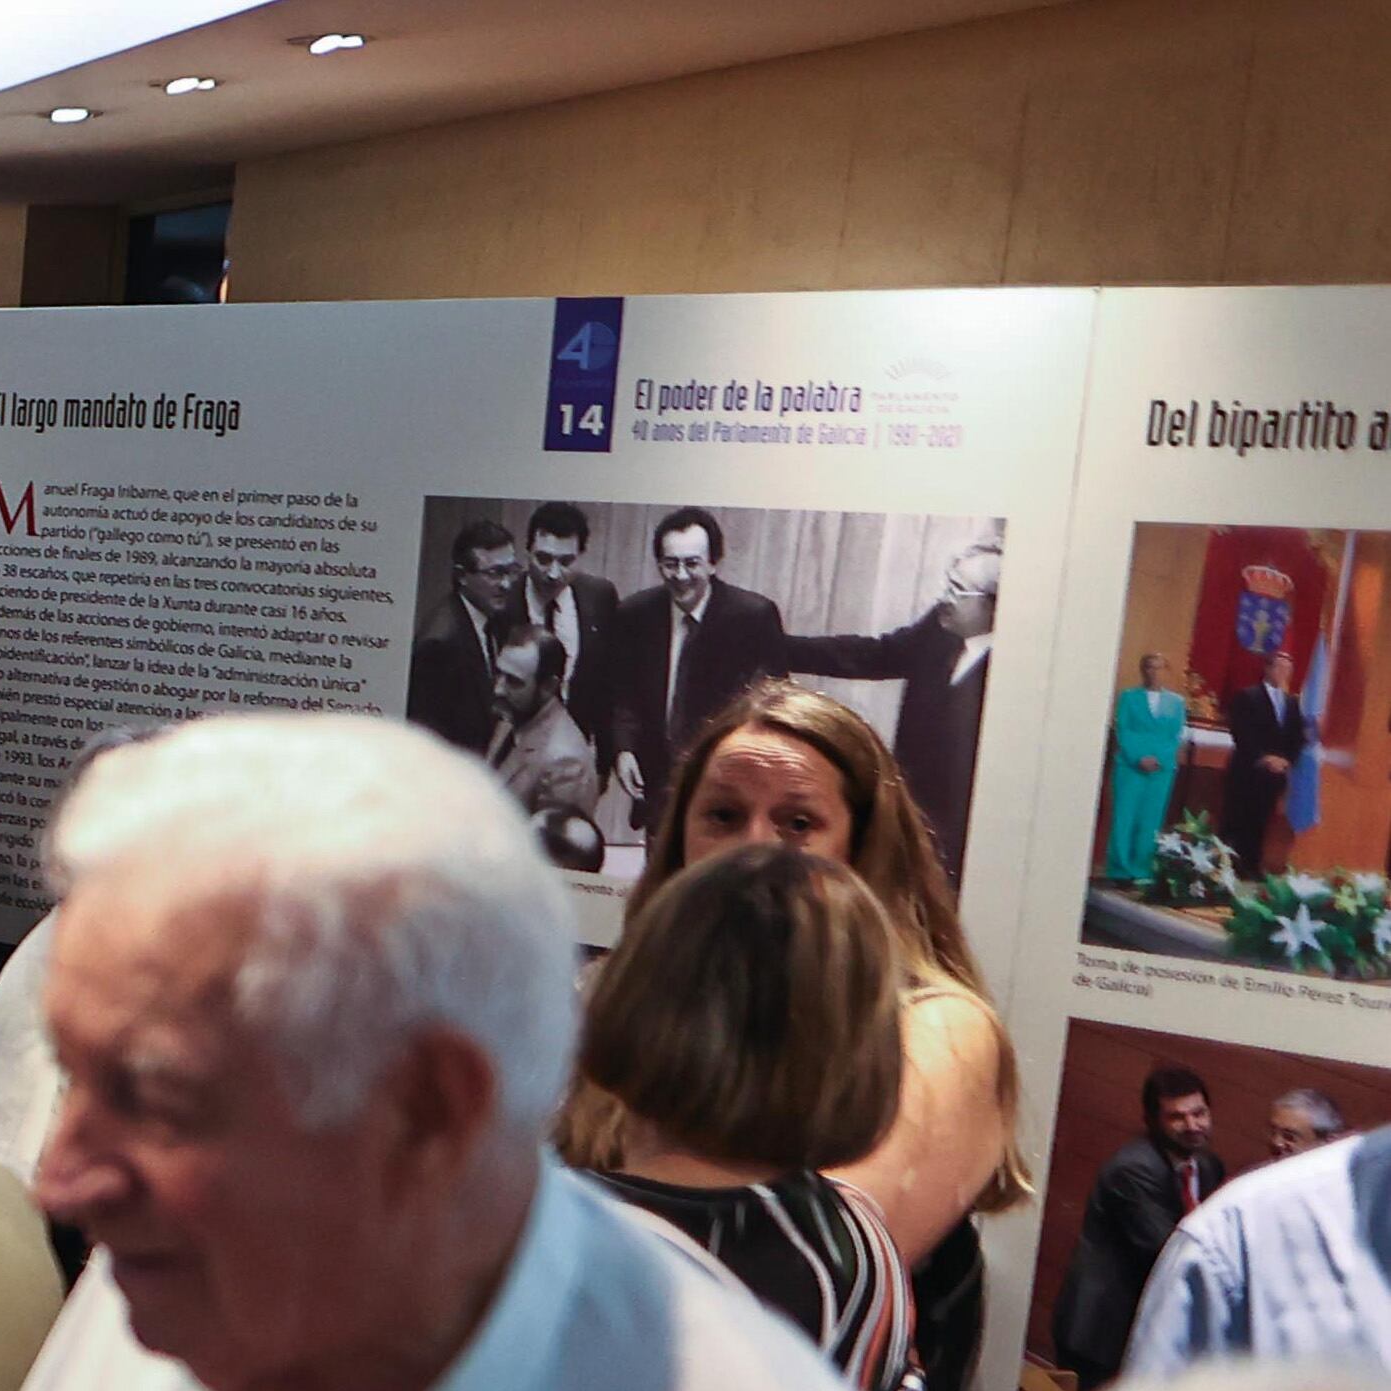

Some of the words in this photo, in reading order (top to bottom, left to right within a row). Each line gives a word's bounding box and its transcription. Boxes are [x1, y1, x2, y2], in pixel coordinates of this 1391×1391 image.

[635, 379, 652, 411] El
[658, 380, 716, 415] poder
[723, 380, 748, 411] de
[755, 381, 773, 412] la
[779, 381, 862, 416] palabra
[11, 392, 57, 434] largo
[63, 392, 147, 429] mandato
[153, 393, 177, 430] de
[183, 393, 240, 437] Fraga
[560, 403, 604, 435] 14
[1147, 400, 1199, 447] Del
[1208, 400, 1357, 457] bipartito
[688, 421, 709, 442] del
[713, 421, 791, 443] Parlamento
[798, 422, 815, 444] de
[81, 483, 114, 503] Fraga
[173, 490, 199, 506] que
[202, 491, 219, 502] en
[222, 488, 235, 503] el
[238, 489, 283, 508] primer
[287, 494, 320, 510] paso
[324, 492, 341, 507] de
[346, 493, 358, 508] la
[43, 503, 109, 520] autonomía
[112, 506, 148, 522] actuó
[152, 507, 167, 522] de
[171, 512, 212, 529] apoyo
[215, 510, 232, 525] de
[236, 511, 254, 526] los
[258, 513, 335, 530] candidatos
[338, 516, 356, 531] de
[361, 521, 377, 532] su
[41, 525, 85, 543] partido
[147, 533, 183, 545] como
[218, 537, 230, 548] se
[235, 536, 296, 553] presentó
[299, 541, 317, 552] en
[321, 538, 340, 553] las
[44, 544, 59, 559] de
[62, 545, 102, 562] finales
[105, 548, 121, 563] de
[162, 552, 236, 570] alcanzando
[240, 556, 251, 571] la
[314, 561, 376, 579] absoluta
[3, 562, 17, 578] 38
[72, 571, 96, 587] que
[154, 576, 169, 588] en
[173, 574, 190, 589] las
[194, 575, 217, 591] tres
[221, 580, 315, 597] convocatorias
[42, 586, 57, 601] de
[60, 589, 125, 606] presidente
[129, 592, 145, 608] de
[148, 593, 159, 609] la
[162, 594, 201, 612] Xunta
[204, 598, 257, 616] durante
[261, 603, 287, 618] casi
[292, 604, 306, 620] 16
[39, 607, 54, 623] de
[57, 608, 73, 624] las
[77, 611, 130, 629] acciones
[133, 614, 149, 630] de
[271, 626, 324, 646] adaptar
[329, 634, 337, 645] o
[342, 632, 390, 649] revisar
[23, 626, 39, 642] de
[42, 628, 58, 644] los
[61, 630, 123, 649] referentes
[198, 641, 215, 657] de
[269, 649, 336, 668] mediante
[340, 653, 351, 669] la
[93, 653, 130, 671] lanzar
[134, 657, 144, 672] la
[148, 658, 175, 675] idea
[178, 661, 195, 677] de
[198, 663, 209, 679] la
[7, 667, 70, 687] alternativa
[73, 673, 89, 689] de
[142, 683, 151, 695] o
[154, 681, 199, 702] abogar
[203, 689, 225, 705] por
[229, 688, 240, 703] la
[243, 690, 298, 709] reforma
[301, 694, 323, 711] del
[64, 695, 114, 713] especial
[174, 707, 182, 718] a
[22, 733, 29, 744] a
[61, 717, 83, 730] con
[86, 715, 103, 732] los
[38, 751, 55, 768] los
[28, 775, 41, 786] su
